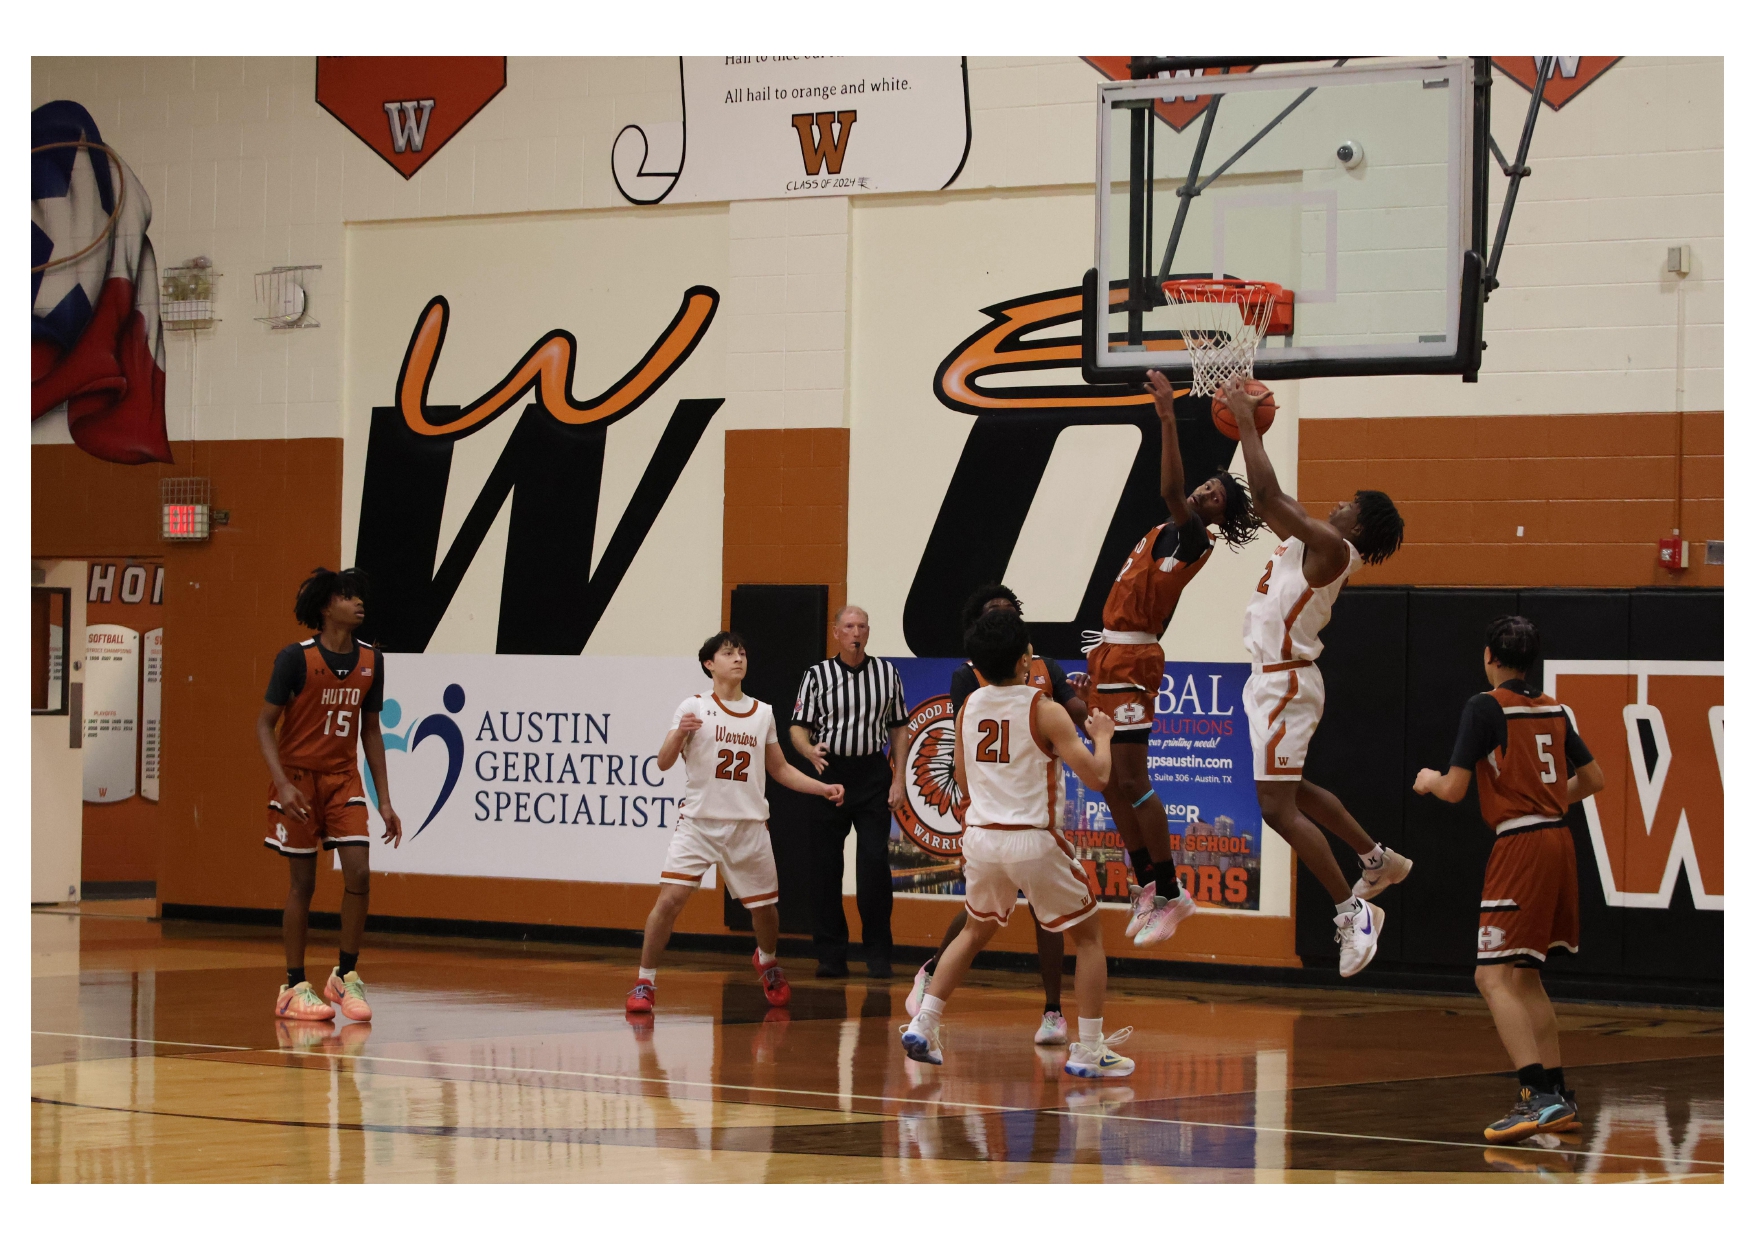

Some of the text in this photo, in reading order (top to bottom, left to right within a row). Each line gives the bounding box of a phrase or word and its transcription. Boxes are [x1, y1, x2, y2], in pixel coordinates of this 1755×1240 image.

[725, 77, 912, 104] All hail to orange and white.
[383, 99, 435, 153] W
[791, 109, 858, 176] W
[785, 179, 819, 191] CLASS
[820, 179, 832, 189] OF
[832, 178, 856, 188] 2024
[169, 505, 196, 534] EXIT
[88, 633, 124, 644] SOFTBALL
[321, 688, 361, 706] HUTTO
[323, 710, 352, 737] 15
[475, 710, 611, 744] AUSTIN
[908, 704, 942, 739] WOOD
[715, 725, 758, 748] Warriors
[976, 719, 1010, 764] 21
[1162, 737, 1192, 750] printing
[1193, 736, 1221, 748] needs!
[475, 750, 665, 787] GERIATRIC
[715, 748, 751, 782] 22
[1277, 756, 1289, 766] W
[1535, 734, 1557, 784] 5
[1154, 773, 1173, 782] Suite
[1174, 774, 1189, 782] 306
[1222, 775, 1232, 783] TX
[1185, 834, 1250, 854] SCHOOL
